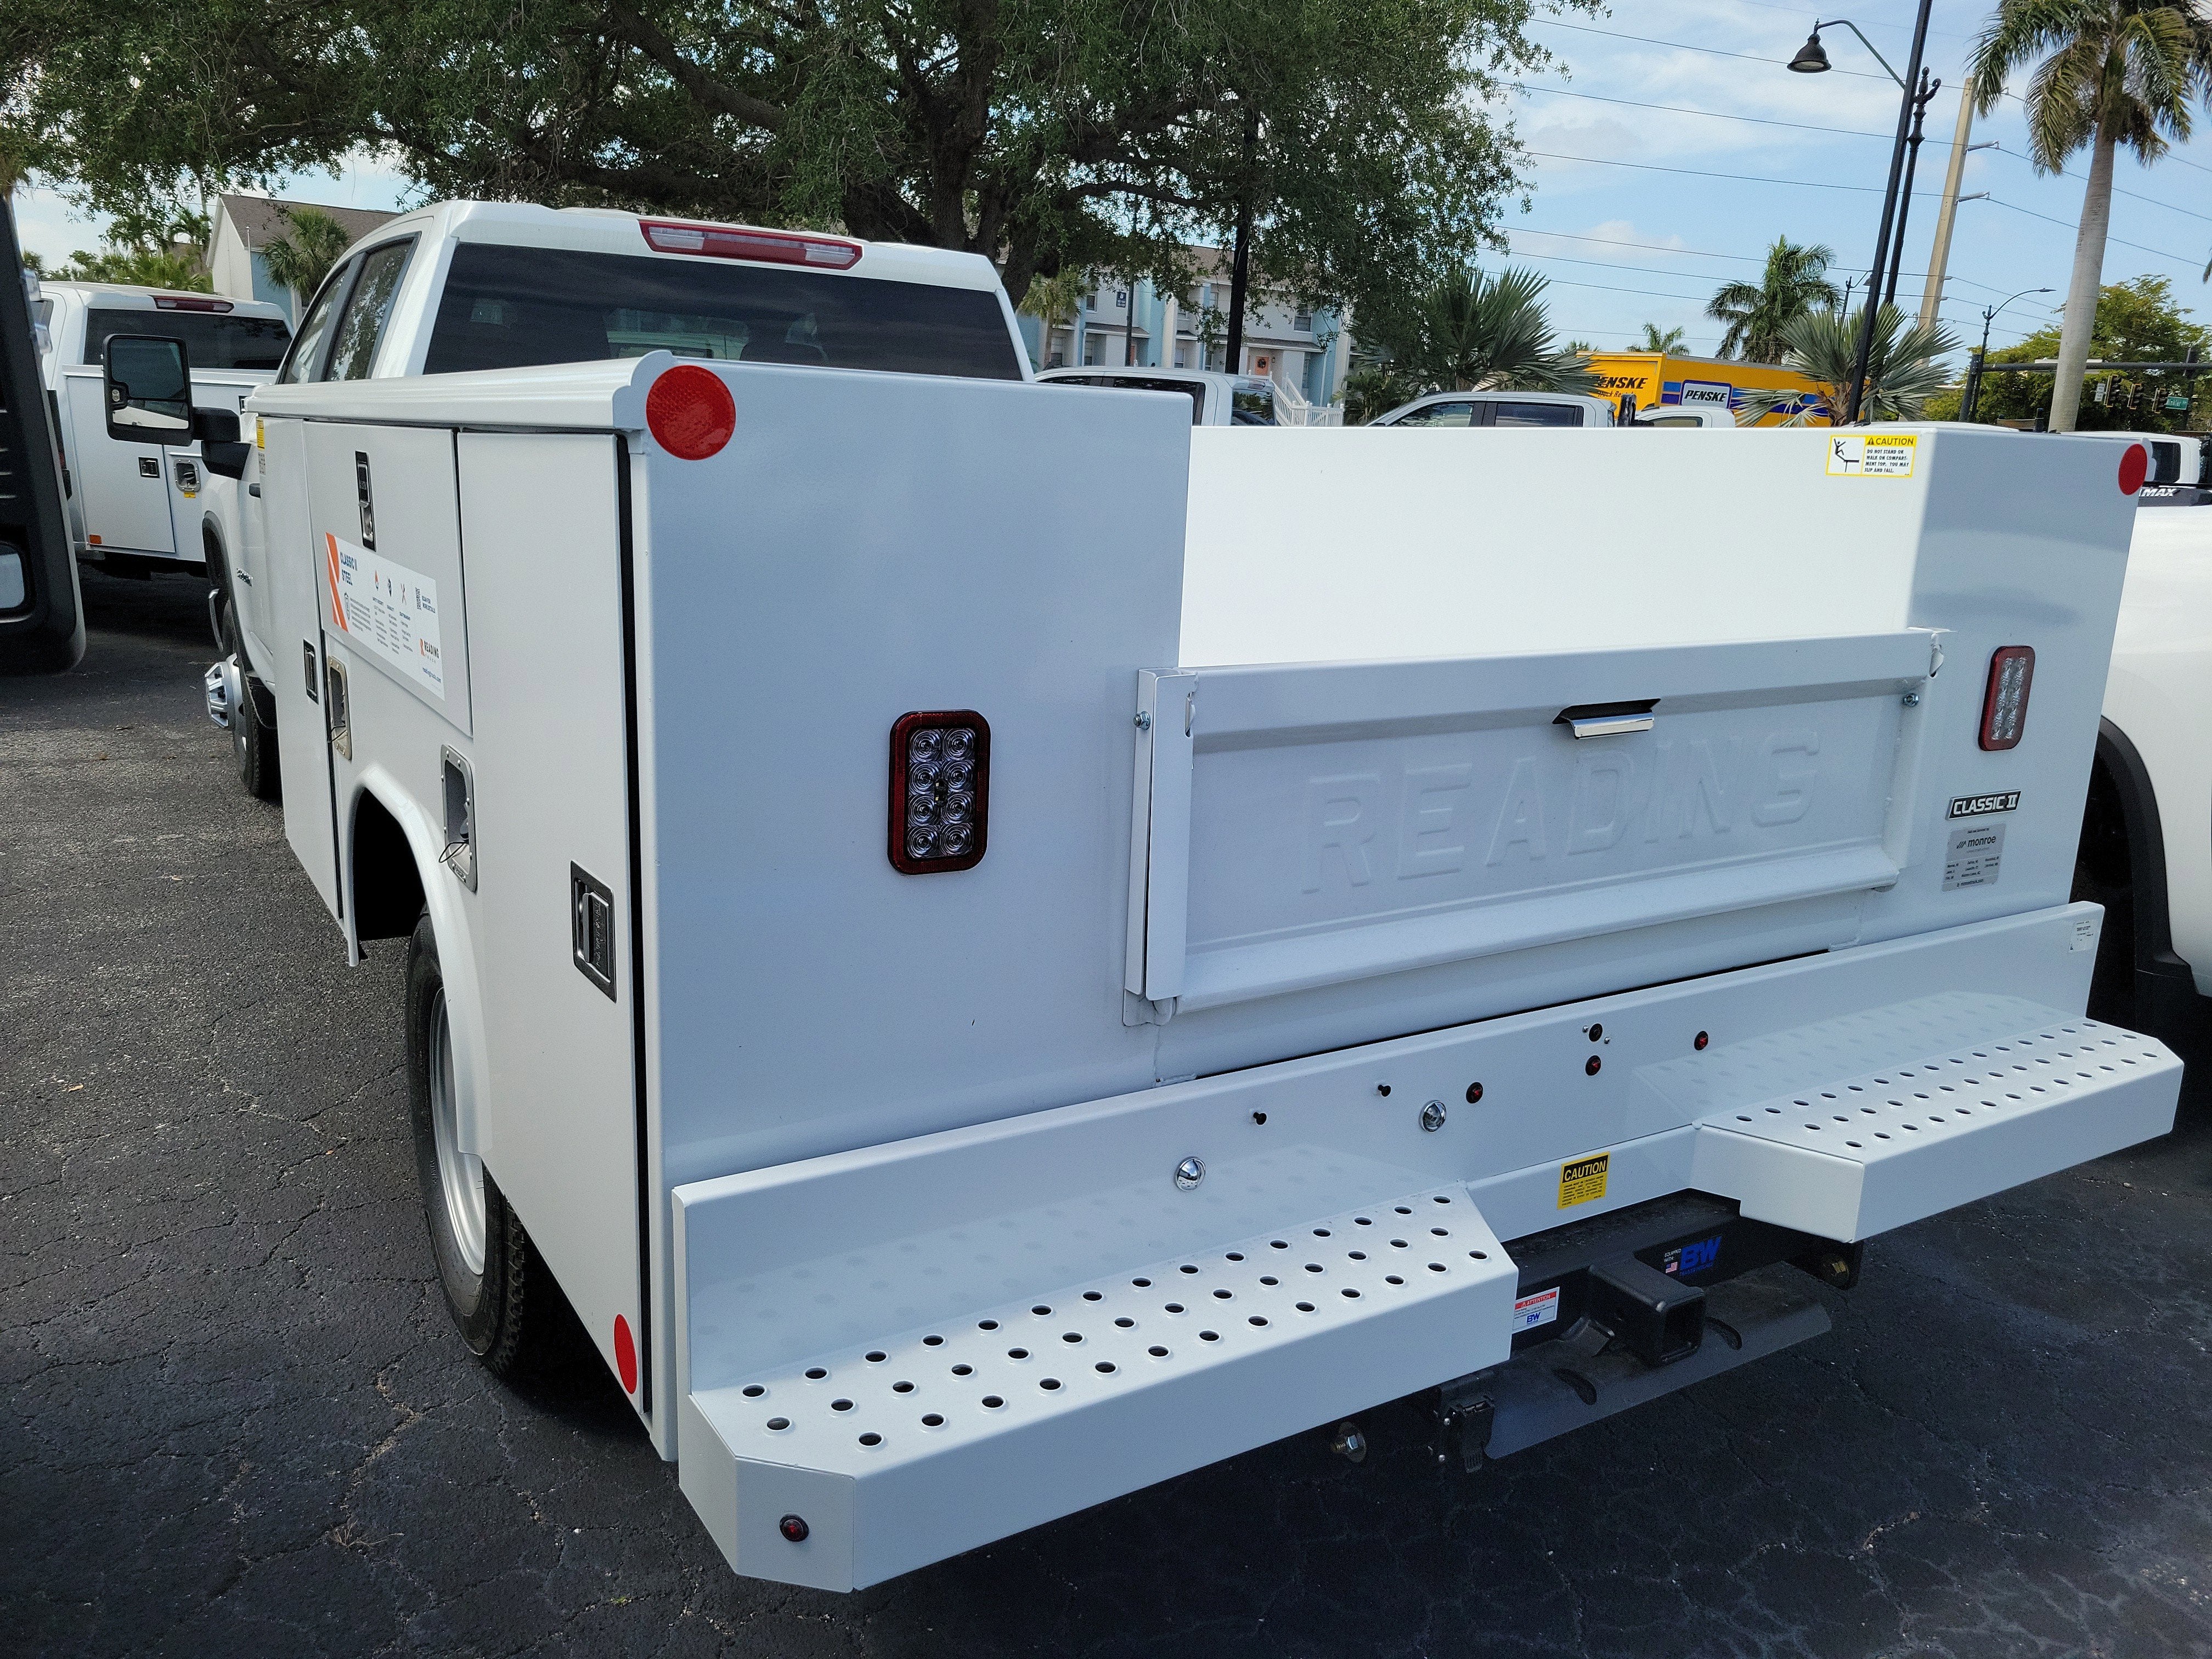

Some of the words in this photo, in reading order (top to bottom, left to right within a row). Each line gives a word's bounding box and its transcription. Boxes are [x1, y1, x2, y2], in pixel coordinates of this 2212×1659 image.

[1594, 376, 1648, 389] ENSKE
[1684, 390, 1727, 402] PENSKE
[2138, 488, 2177, 496] MAX
[340, 551, 354, 570] CLASSIC
[342, 569, 353, 585] STEEL
[424, 640, 439, 658] READING
[1302, 731, 1820, 894] READING
[1954, 796, 2006, 815] CLASSIC
[2007, 794, 2018, 808] II
[1968, 836, 1996, 847] monroe
[1564, 1160, 1606, 1181] CAUTION
[1527, 1295, 1550, 1305] ATTENTION
